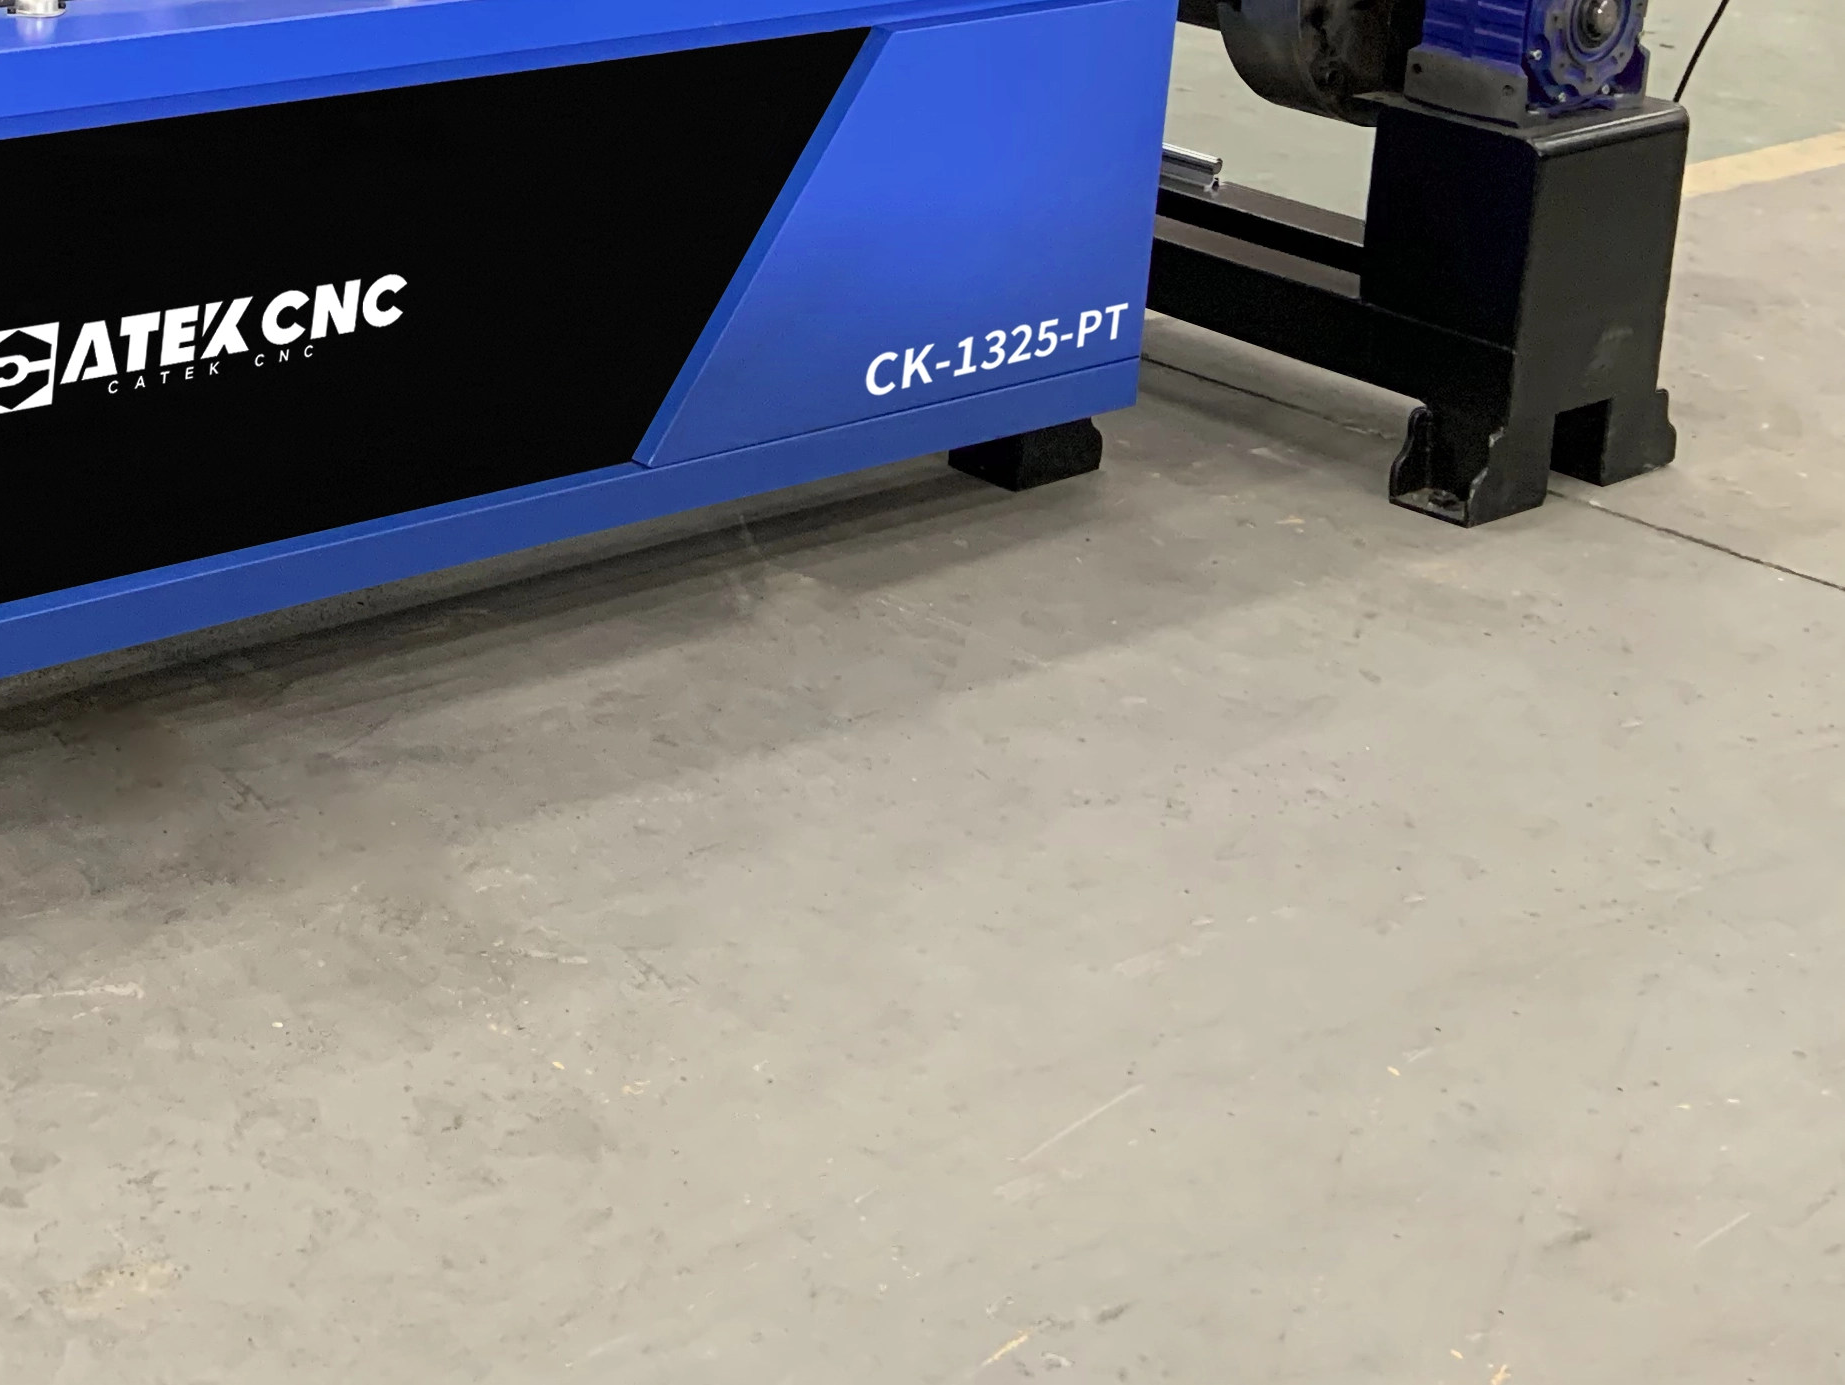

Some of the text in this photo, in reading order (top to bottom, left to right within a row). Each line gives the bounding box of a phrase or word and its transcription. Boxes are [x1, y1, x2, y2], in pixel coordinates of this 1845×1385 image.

[261, 274, 408, 346] CNC
[108, 345, 314, 395] CATEK CNC
[865, 302, 1129, 397] CK-1325-PT
